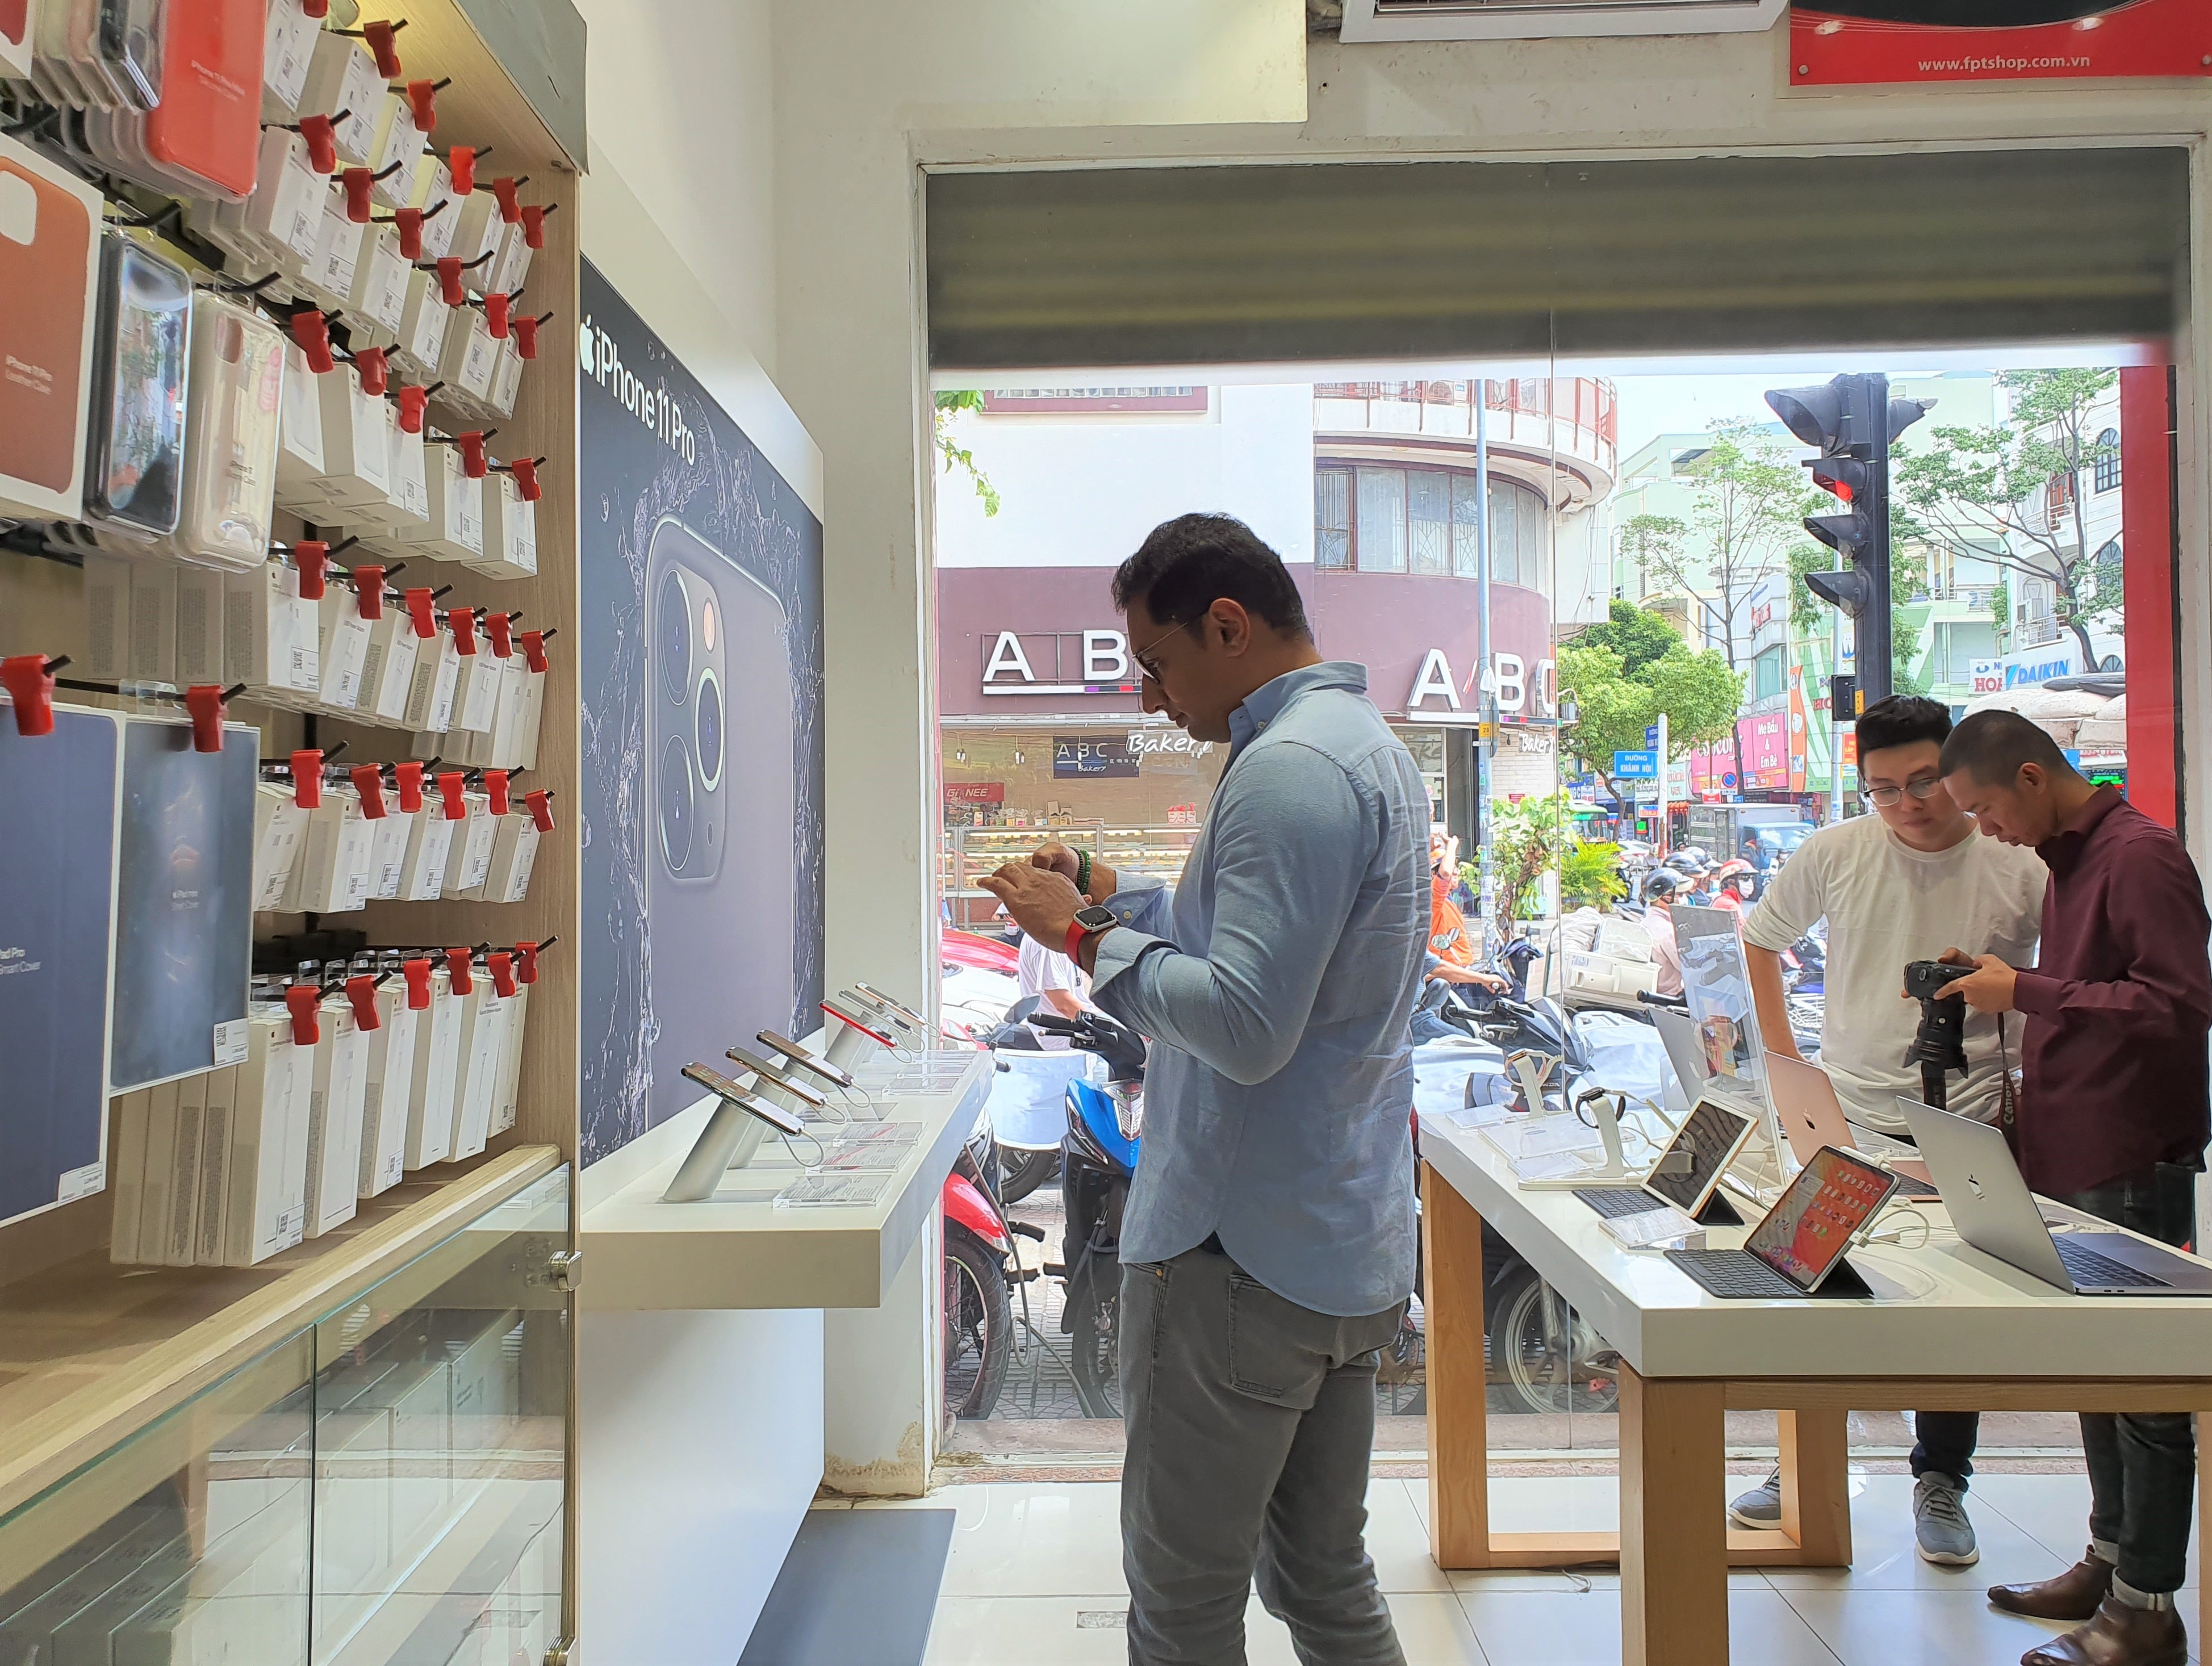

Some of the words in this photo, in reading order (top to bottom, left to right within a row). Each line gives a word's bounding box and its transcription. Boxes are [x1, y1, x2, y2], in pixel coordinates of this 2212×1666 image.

[1918, 55, 2090, 72] www.fptshop.com.vn
[596, 326, 655, 430] iPhone
[657, 389, 669, 445] 11
[672, 402, 695, 466] Pro
[2018, 658, 2070, 684] DAIKIN
[1764, 738, 1770, 751] &
[1761, 756, 1770, 768] Em
[2003, 1082, 2014, 1124] Canon
